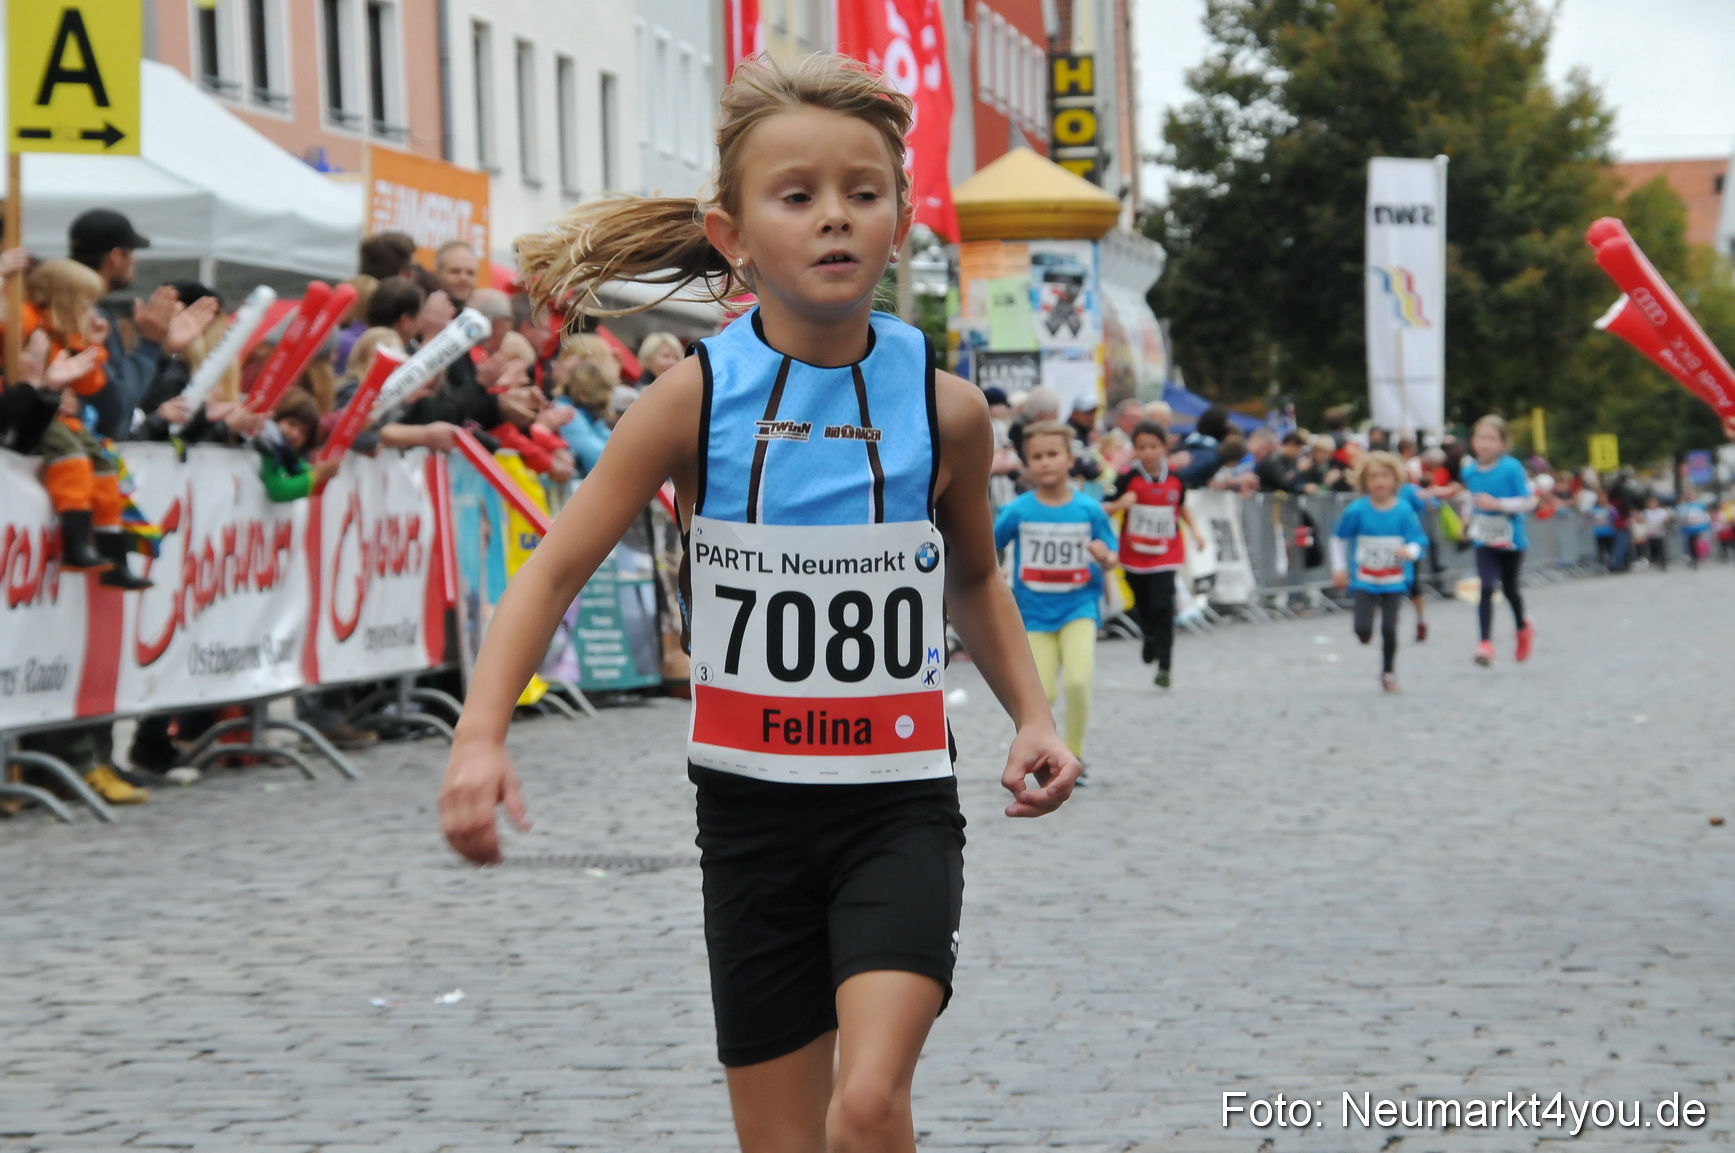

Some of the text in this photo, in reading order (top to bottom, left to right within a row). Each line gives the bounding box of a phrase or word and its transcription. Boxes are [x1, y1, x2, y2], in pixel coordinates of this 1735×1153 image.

[36, 8, 110, 107] A
[695, 542, 906, 575] PARTL Neumarkt
[1029, 540, 1086, 564] 7091
[714, 584, 924, 683] 7080
[700, 667, 708, 681] 3
[762, 708, 873, 746] Felina
